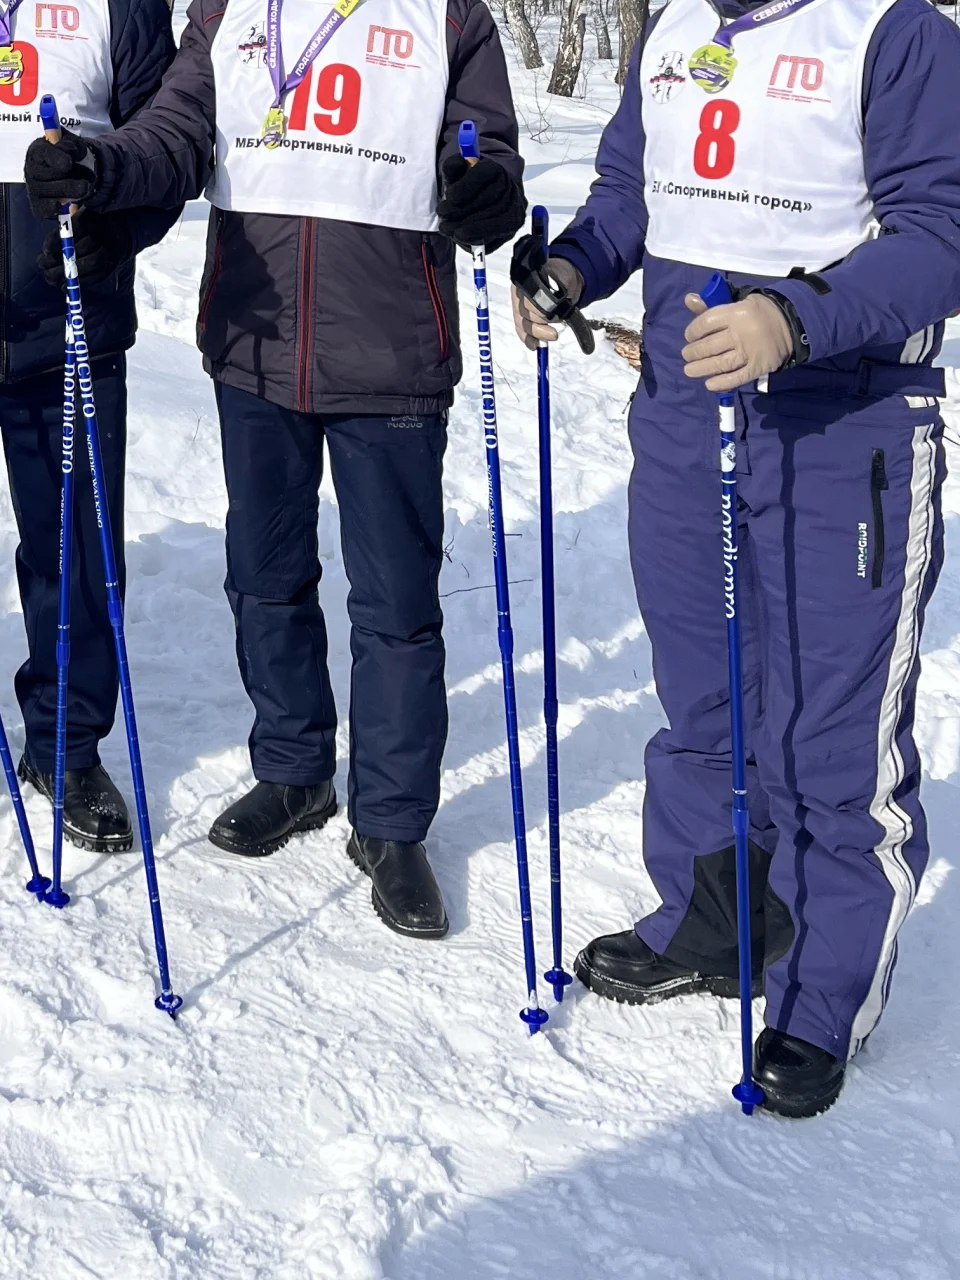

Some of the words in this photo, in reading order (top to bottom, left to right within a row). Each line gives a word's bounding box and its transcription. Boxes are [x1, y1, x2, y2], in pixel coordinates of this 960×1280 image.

[34, 2, 80, 31] ГТО
[269, 23, 278, 69] СЕВЕРНАЯ
[295, 11, 341, 78] ПОДСНЕЖНИКИ
[366, 24, 414, 59] ГТО
[768, 53, 825, 92] ГТО
[287, 63, 362, 137] 19
[235, 137, 263, 149] МБУ
[357, 147, 407, 166] город»
[693, 98, 741, 180] 8
[663, 181, 750, 203] «Спортивный
[754, 194, 813, 214] город»
[86, 433, 97, 477] NORDIC
